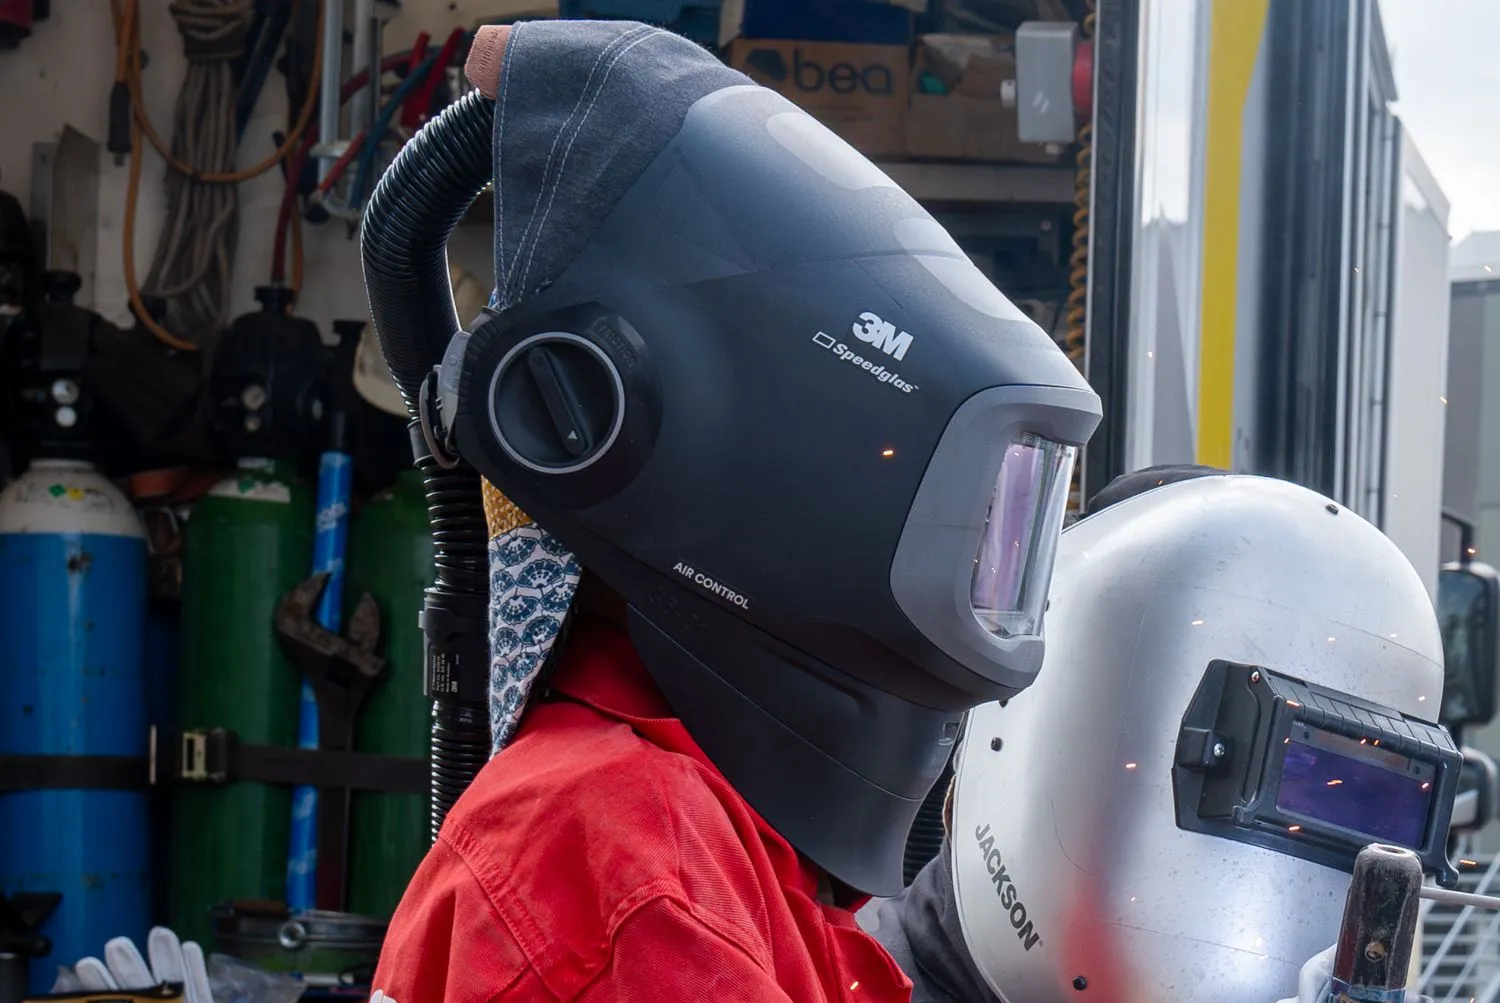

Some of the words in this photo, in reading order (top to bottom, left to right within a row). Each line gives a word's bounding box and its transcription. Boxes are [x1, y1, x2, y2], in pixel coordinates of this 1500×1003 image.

[852, 311, 914, 361] 3M
[832, 343, 914, 393] Speedglas
[673, 562, 695, 578] AIR
[694, 573, 749, 610] CONTROL
[975, 823, 1040, 952] JACKSON
